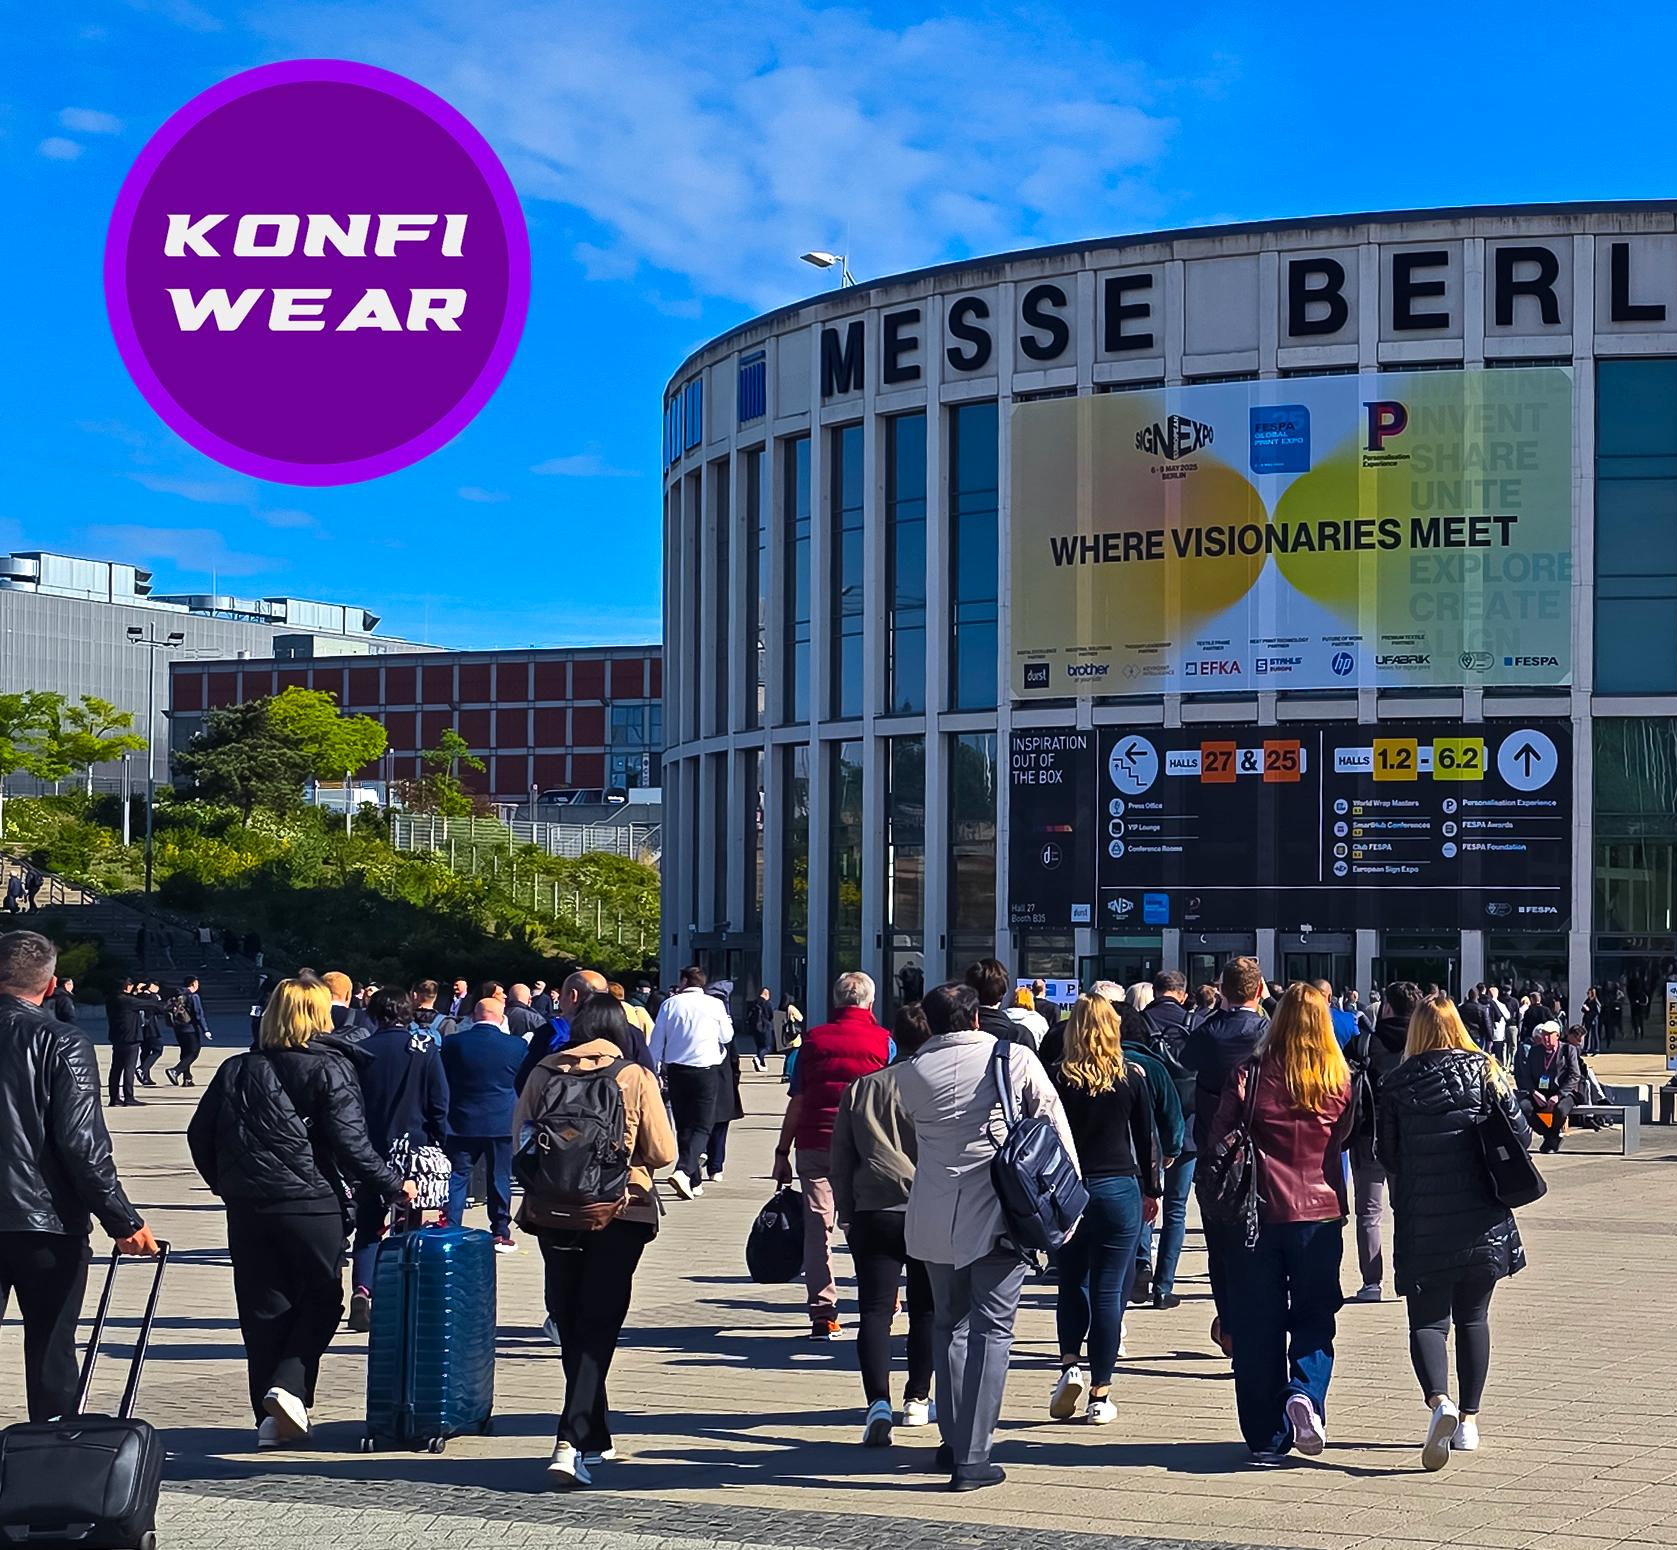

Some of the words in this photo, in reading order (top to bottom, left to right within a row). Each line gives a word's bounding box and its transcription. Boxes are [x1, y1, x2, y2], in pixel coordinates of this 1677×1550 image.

[820, 273, 1154, 398] MESSE
[1411, 403, 1548, 433] INVENT
[1255, 422, 1296, 432] FESPA
[1363, 401, 1408, 451] P
[1411, 441, 1538, 473] SHARE
[1162, 472, 1186, 480] BERLIN
[1411, 479, 1522, 510] UNITE
[1050, 529, 1165, 567] WHERE
[1170, 517, 1402, 558] VISIONARIES
[1410, 515, 1518, 549] MEET
[1409, 552, 1572, 584] EXPLORE
[1409, 590, 1560, 622] CREATE
[1200, 661, 1241, 675] EFKA
[1334, 654, 1351, 675] hp
[1515, 657, 1559, 666] FESPA
[1027, 669, 1047, 682] durst
[1067, 663, 1109, 677] brother
[1013, 736, 1087, 751] INSPIRATION
[1013, 754, 1036, 768] OUT
[1039, 753, 1055, 767] OF
[1169, 759, 1198, 768] HALLS
[1204, 750, 1232, 772] 27
[1240, 750, 1259, 772] &
[1266, 750, 1297, 771] 25
[1338, 756, 1370, 766] HALLS
[1377, 748, 1412, 770] 1.2
[1438, 748, 1479, 769] 6.2
[1013, 771, 1035, 784] THE
[1039, 770, 1063, 784] BOX
[1128, 802, 1144, 810] Press
[1139, 824, 1160, 832] Lounge
[1011, 904, 1026, 912] Hall
[1027, 904, 1035, 912] 27
[1011, 914, 1031, 923] Booth
